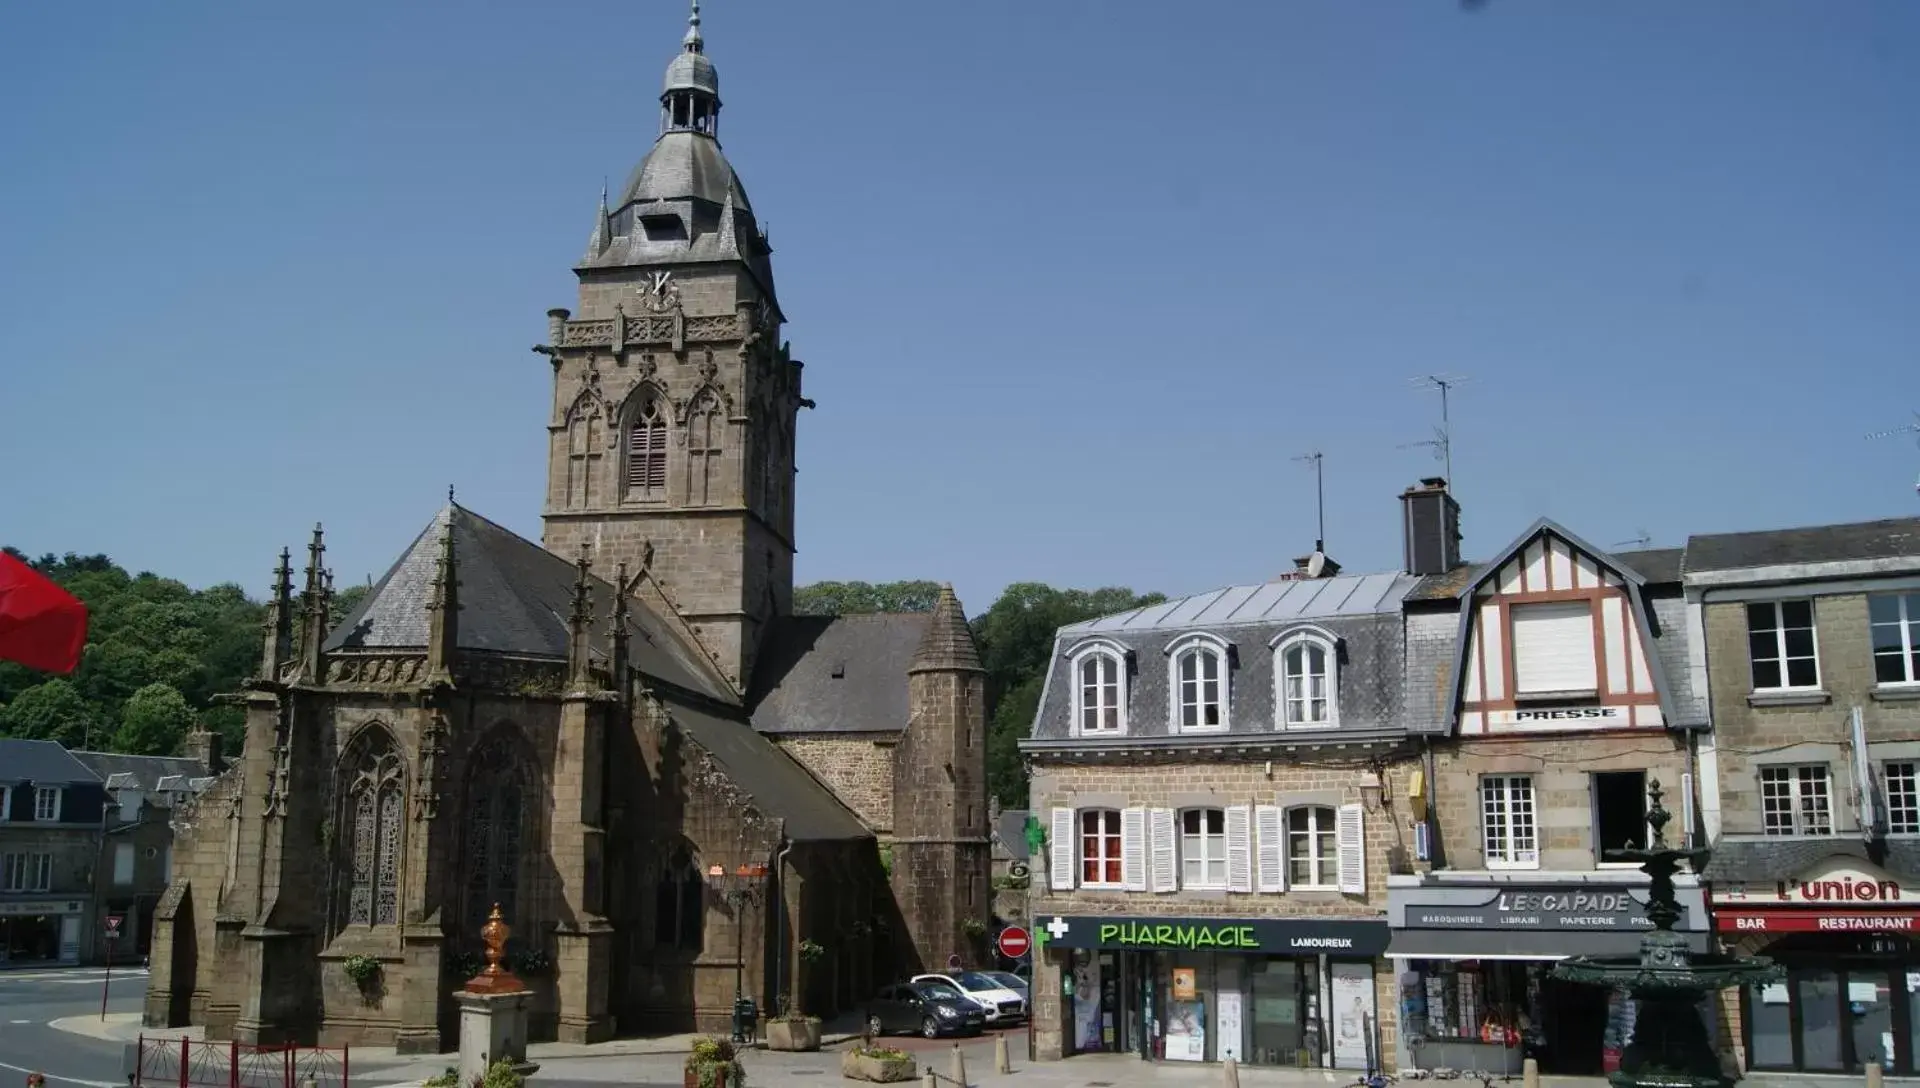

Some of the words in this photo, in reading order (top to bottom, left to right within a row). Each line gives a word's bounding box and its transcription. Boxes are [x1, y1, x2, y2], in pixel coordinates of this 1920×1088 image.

[1516, 708, 1617, 720] PRESSE
[1560, 916, 1616, 925] PAPETERIE
[1736, 918, 1766, 929] BAR
[1818, 917, 1914, 930] RESTAURANT
[1100, 920, 1260, 950] PHARMACIE
[1290, 937, 1353, 948] LAMOUREUX
